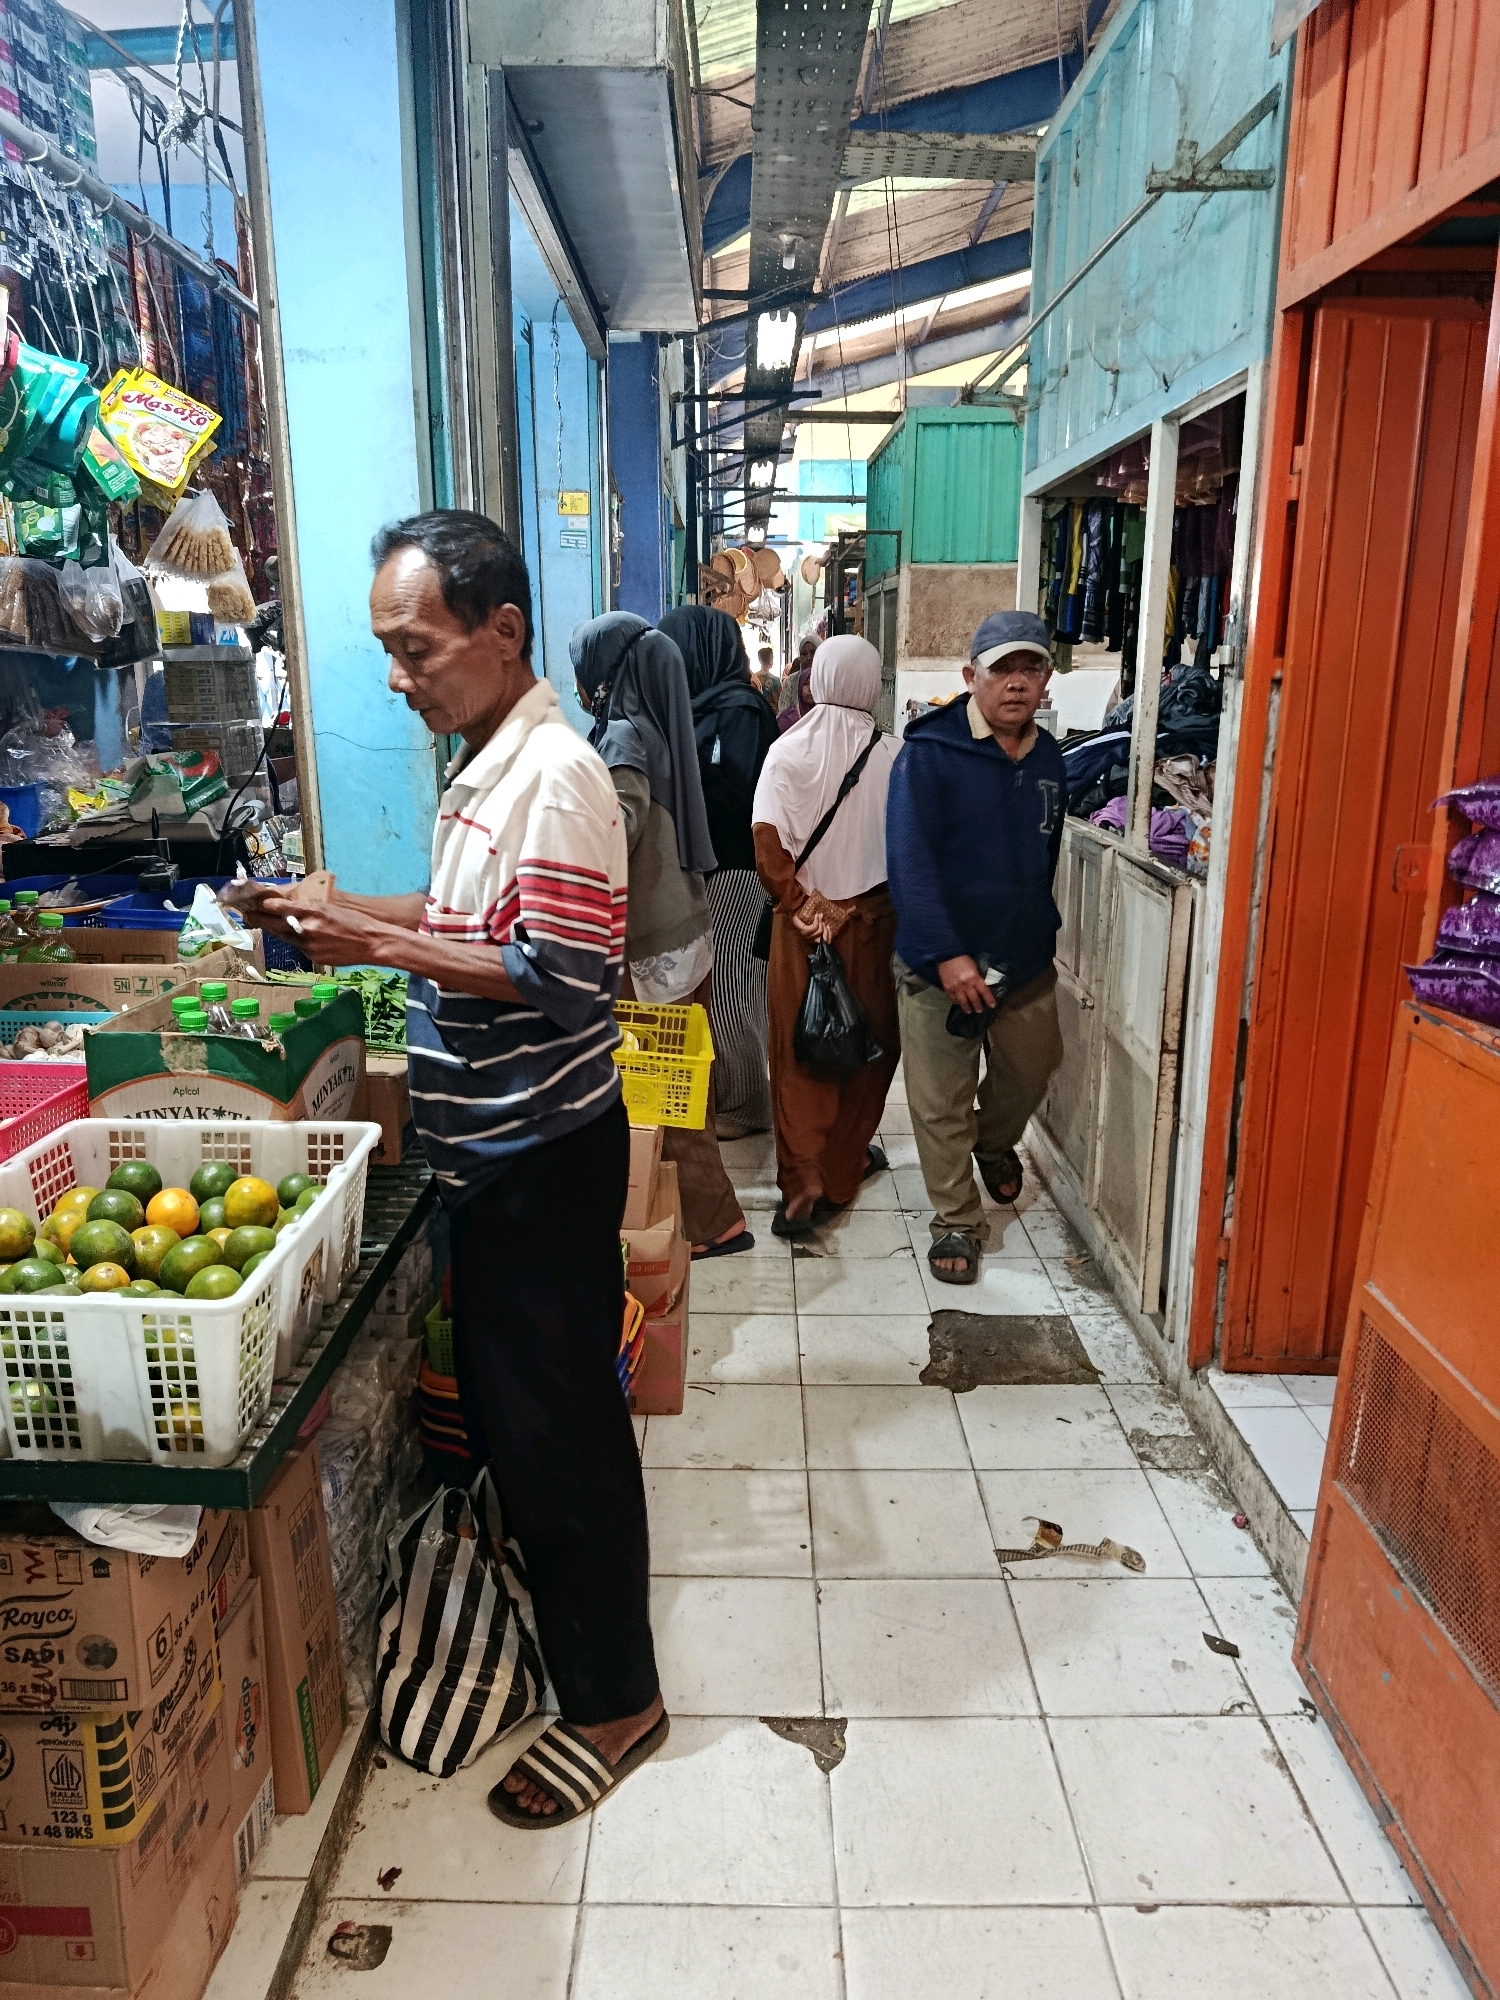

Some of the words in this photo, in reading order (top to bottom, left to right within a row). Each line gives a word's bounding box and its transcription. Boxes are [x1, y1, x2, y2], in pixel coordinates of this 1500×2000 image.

[40, 980, 68, 988] wilmar
[114, 980, 131, 992] SNI
[138, 978, 148, 990] 7
[185, 1530, 209, 1576] SAPI
[0, 1607, 72, 1631] Royco
[155, 1627, 167, 1659] 6
[4, 1646, 65, 1665] SAPI
[51, 1811, 78, 1824] 123
[82, 1814, 92, 1827] g
[19, 1823, 27, 1836] 1
[31, 1826, 40, 1837] x
[44, 1825, 62, 1838] 48
[65, 1826, 94, 1840] BKS
